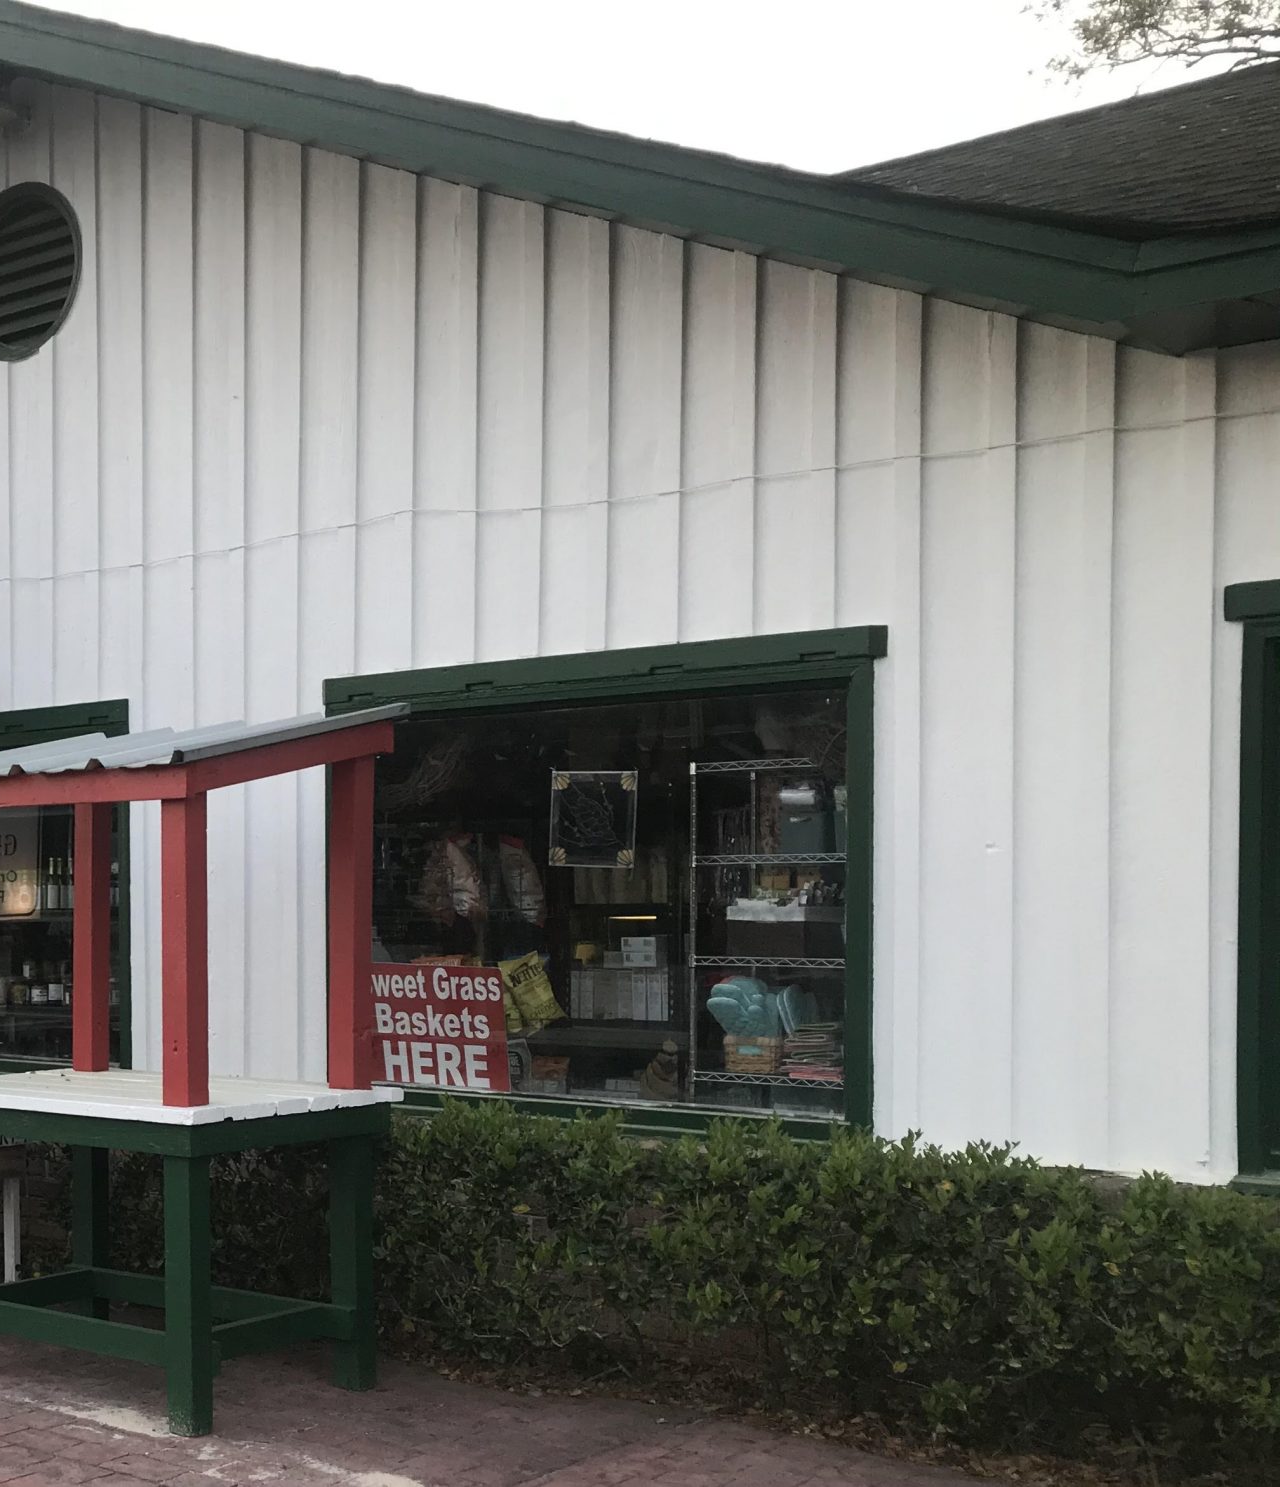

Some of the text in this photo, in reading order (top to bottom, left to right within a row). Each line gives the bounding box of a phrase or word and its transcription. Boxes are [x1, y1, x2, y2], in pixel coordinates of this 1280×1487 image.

[370, 967, 501, 1002] weet Grass
[374, 1003, 490, 1039] Baskets
[382, 1040, 490, 1089] HERE
